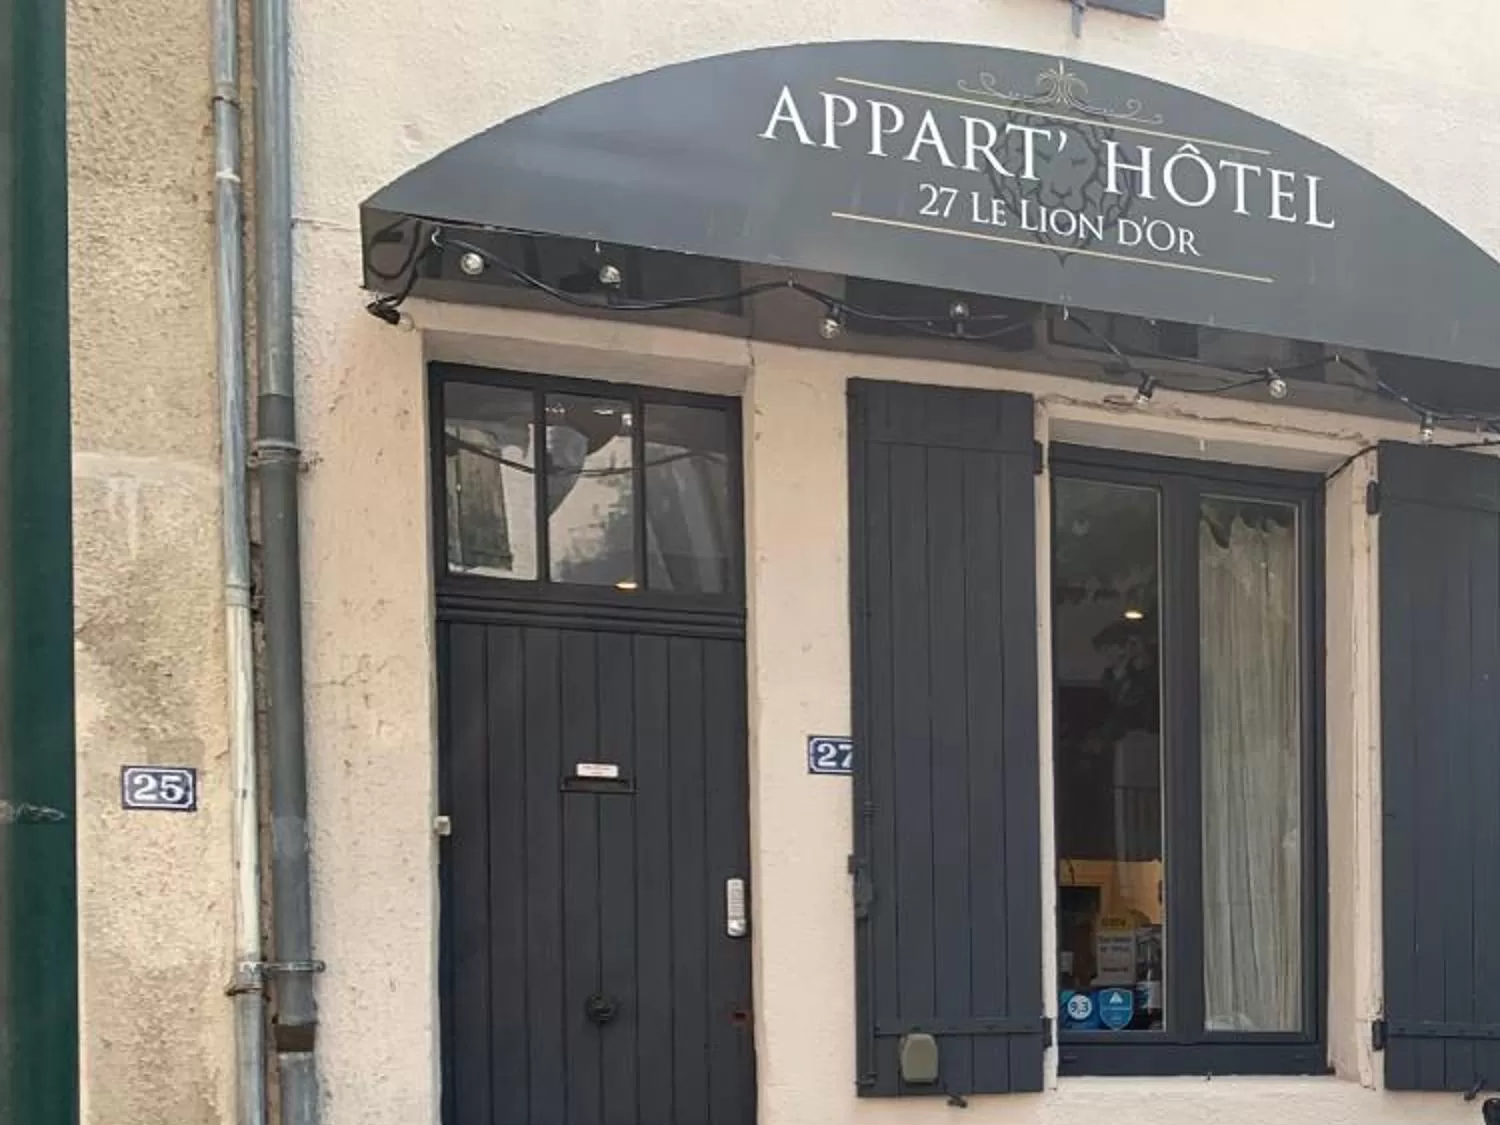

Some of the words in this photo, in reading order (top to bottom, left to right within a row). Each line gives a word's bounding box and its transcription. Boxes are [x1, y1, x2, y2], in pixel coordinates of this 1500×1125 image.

[757, 85, 1067, 181] APPART'
[1102, 140, 1336, 230] HÔTEL
[919, 184, 958, 218] 27
[971, 192, 1006, 227] LE
[1021, 199, 1104, 242] LION
[1118, 214, 1202, 257] D'OR
[818, 743, 853, 768] 27
[133, 774, 185, 802] 25
